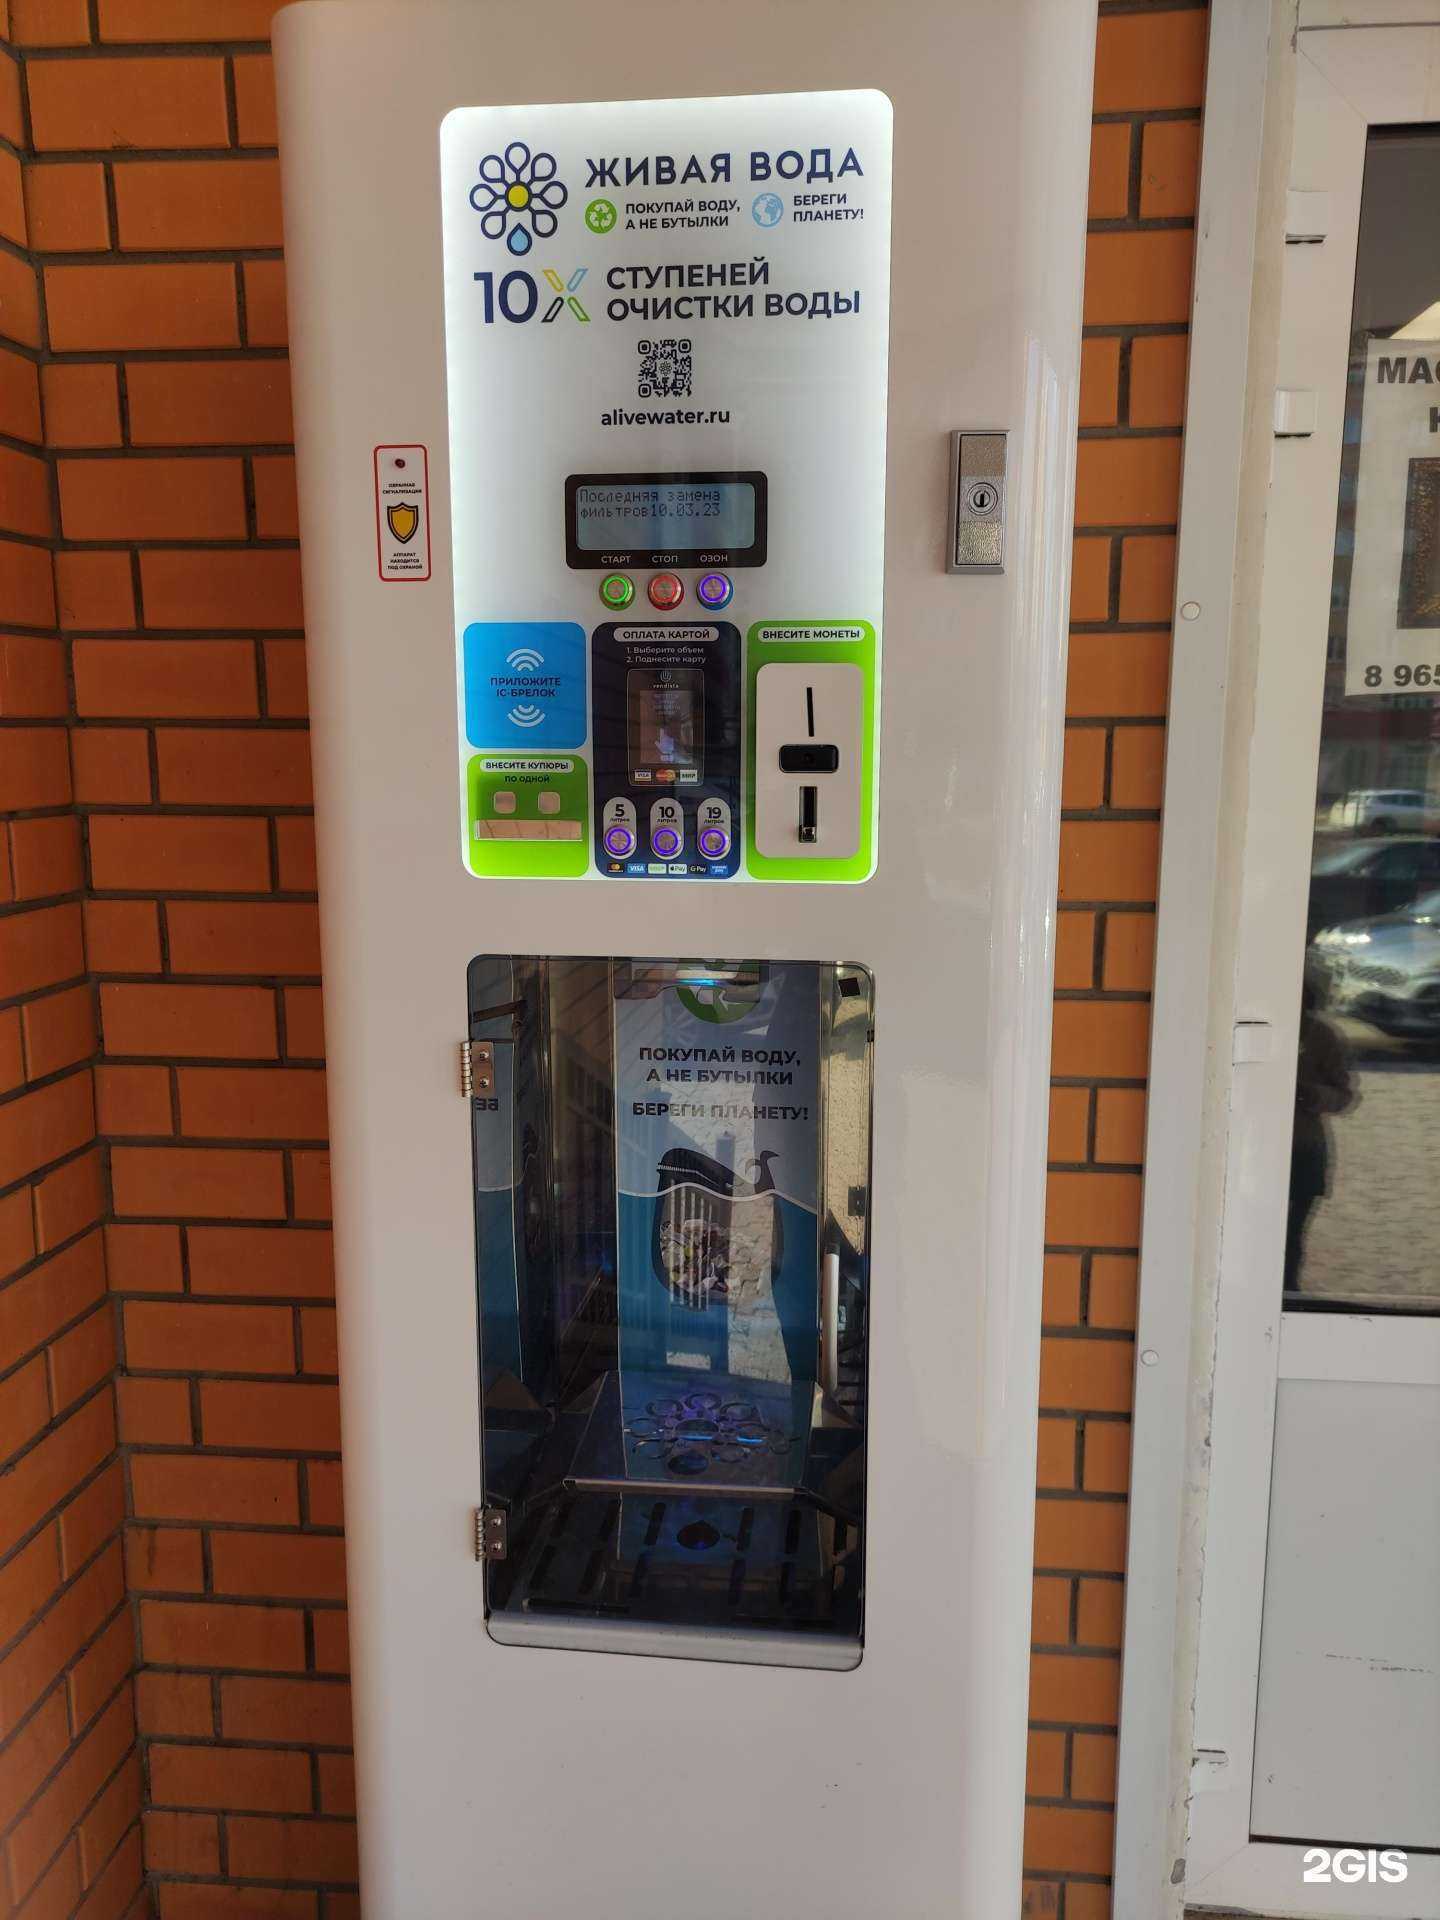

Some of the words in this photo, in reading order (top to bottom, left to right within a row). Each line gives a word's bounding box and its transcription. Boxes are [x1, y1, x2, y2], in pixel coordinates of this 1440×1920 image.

[585, 153, 732, 188] ЖИВАЯ
[749, 147, 864, 184] ВОДА
[793, 193, 848, 206] БЕРЕГИ
[625, 199, 695, 214] ПОКУПАЙ
[698, 199, 741, 213] ВОДУ,
[793, 208, 865, 222] ПЛАНЕТУ!
[625, 218, 636, 230] А
[638, 217, 658, 229] НЕ
[661, 214, 730, 229] БУТЫЛКИ
[606, 256, 770, 290] СТУПЕНЕЙ
[606, 294, 755, 321] ОЧИСТКИ
[764, 290, 860, 319] ВОДЫ
[1377, 356, 1440, 385] МА
[601, 408, 731, 426] alivewater.ru
[579, 489, 659, 503] Последняя
[667, 489, 721, 501] замена
[601, 555, 632, 564] СТАРТ
[652, 554, 678, 563] СТОП
[700, 554, 728, 563] ОЗОН
[623, 631, 666, 639] ОПЛАТА
[668, 629, 710, 639] КАРТОЙ
[762, 630, 811, 639] ВНЕСИТЕ
[813, 630, 860, 638] МОНЕТЫ
[633, 647, 676, 655] Выберите
[635, 656, 681, 664] Поднесите
[682, 657, 706, 665] карту
[490, 677, 561, 687] ПРИЛОЖИТЕ
[1364, 664, 1382, 687] 8
[485, 762, 527, 770] ВНЕСИТЕ
[528, 761, 569, 770] КУПЮРЫ
[504, 775, 517, 783] ПО
[518, 775, 550, 784] ОДНОЙ
[615, 804, 625, 817] 5
[659, 806, 675, 818] 10
[707, 806, 722, 819] 19
[638, 1046, 736, 1063] ПОКУПАЙ
[741, 1049, 801, 1067] ВОДУ,
[646, 1068, 661, 1082] А
[666, 1069, 692, 1082] НЕ
[696, 1069, 793, 1085] БУТЫЛКИ
[632, 1102, 706, 1117] БЕРЕГИ
[710, 1104, 809, 1121] ПЛАНЕТУ!
